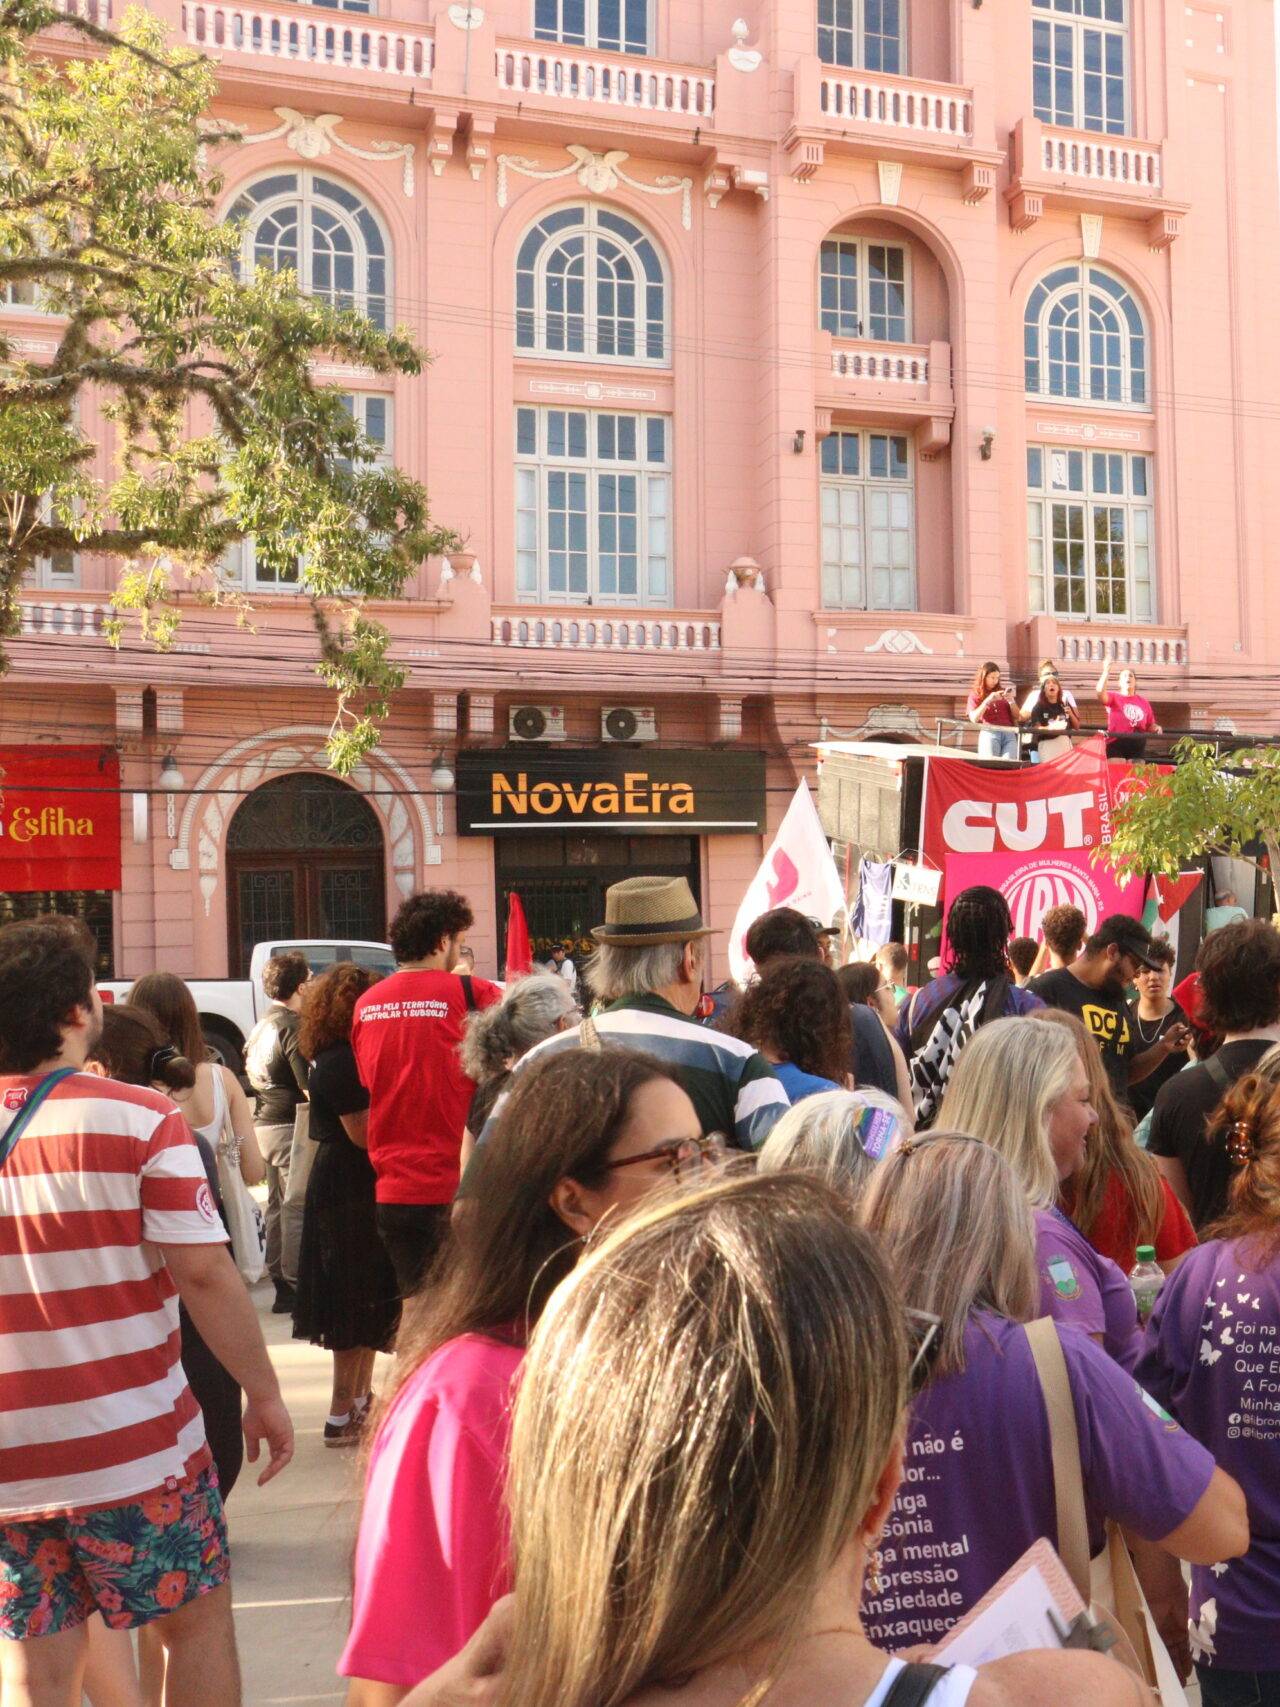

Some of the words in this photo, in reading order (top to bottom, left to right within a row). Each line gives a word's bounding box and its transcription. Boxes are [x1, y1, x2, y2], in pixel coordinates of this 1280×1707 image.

[491, 772, 695, 815] NovaEra
[9, 806, 94, 842] Esfiha
[942, 791, 1094, 853] CUT
[1098, 785, 1112, 844] BRASIL
[1235, 1321, 1257, 1335] Foi
[1259, 1325, 1276, 1336] na
[1235, 1340, 1254, 1354] do
[1234, 1359, 1264, 1373] Que
[1243, 1379, 1254, 1391] A
[1240, 1397, 1280, 1411] Minha
[911, 1433, 945, 1456] não
[951, 1430, 964, 1451] é
[881, 1514, 934, 1538] sônia
[903, 1534, 970, 1560] mental
[863, 1613, 964, 1640] Enxaquec
